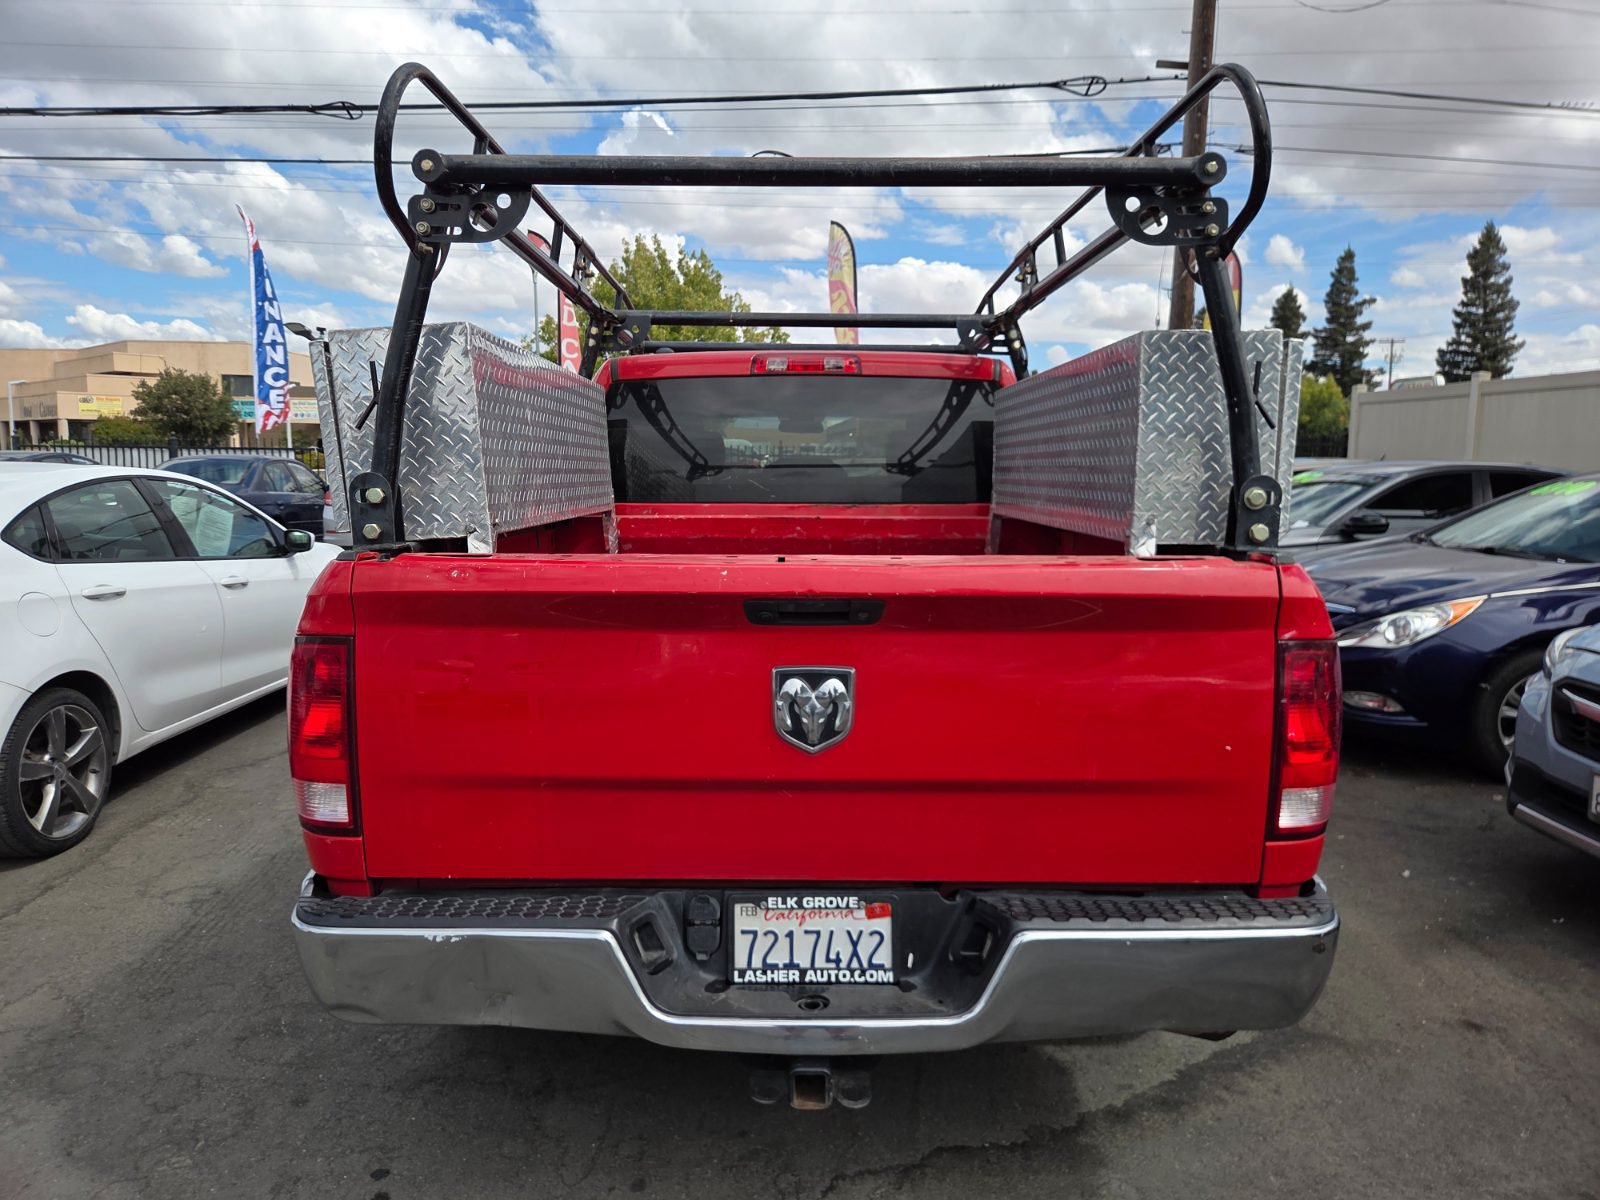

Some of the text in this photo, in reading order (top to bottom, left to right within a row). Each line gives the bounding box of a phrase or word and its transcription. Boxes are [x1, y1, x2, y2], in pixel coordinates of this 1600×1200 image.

[768, 896, 859, 909] ELK GROVE
[740, 906, 758, 917] FEB
[740, 929, 886, 969] 72174X2
[734, 970, 894, 983] LASHER AUTO.COM
